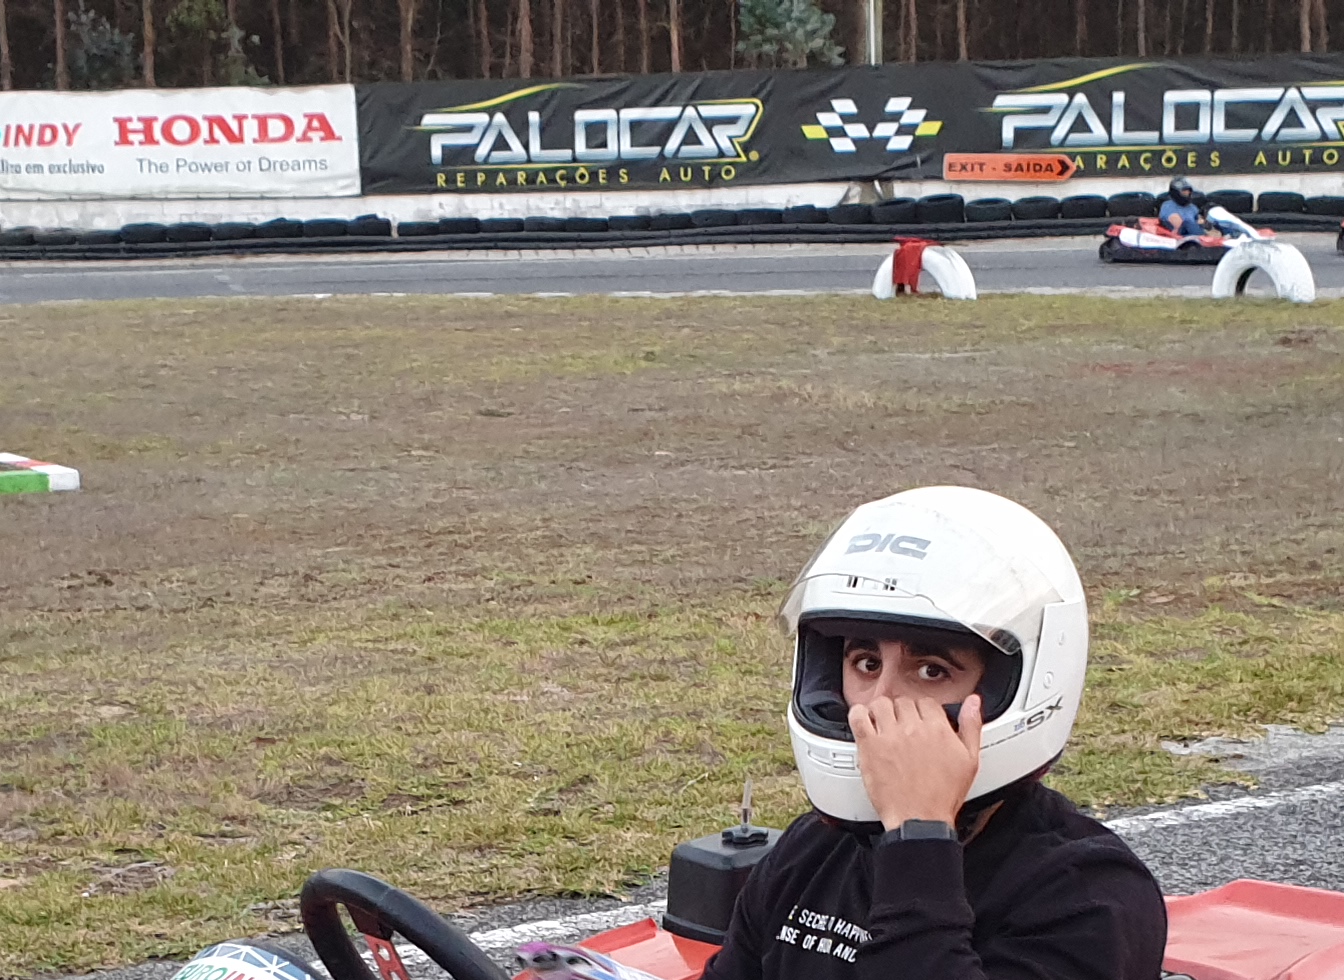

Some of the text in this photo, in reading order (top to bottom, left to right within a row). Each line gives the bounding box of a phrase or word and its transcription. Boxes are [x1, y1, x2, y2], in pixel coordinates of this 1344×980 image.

[113, 112, 342, 147] HONDA
[421, 103, 758, 164] PALOCAR
[25, 162, 44, 174] em
[48, 159, 105, 174] exclusivo
[136, 156, 328, 174] The Power of Dreams
[948, 162, 986, 173] EXIT
[1002, 160, 1054, 173] SAÍDA
[1074, 148, 1338, 171] ARAÇÕES AUTO
[437, 164, 736, 188] REPARAÇÕES AUTO
